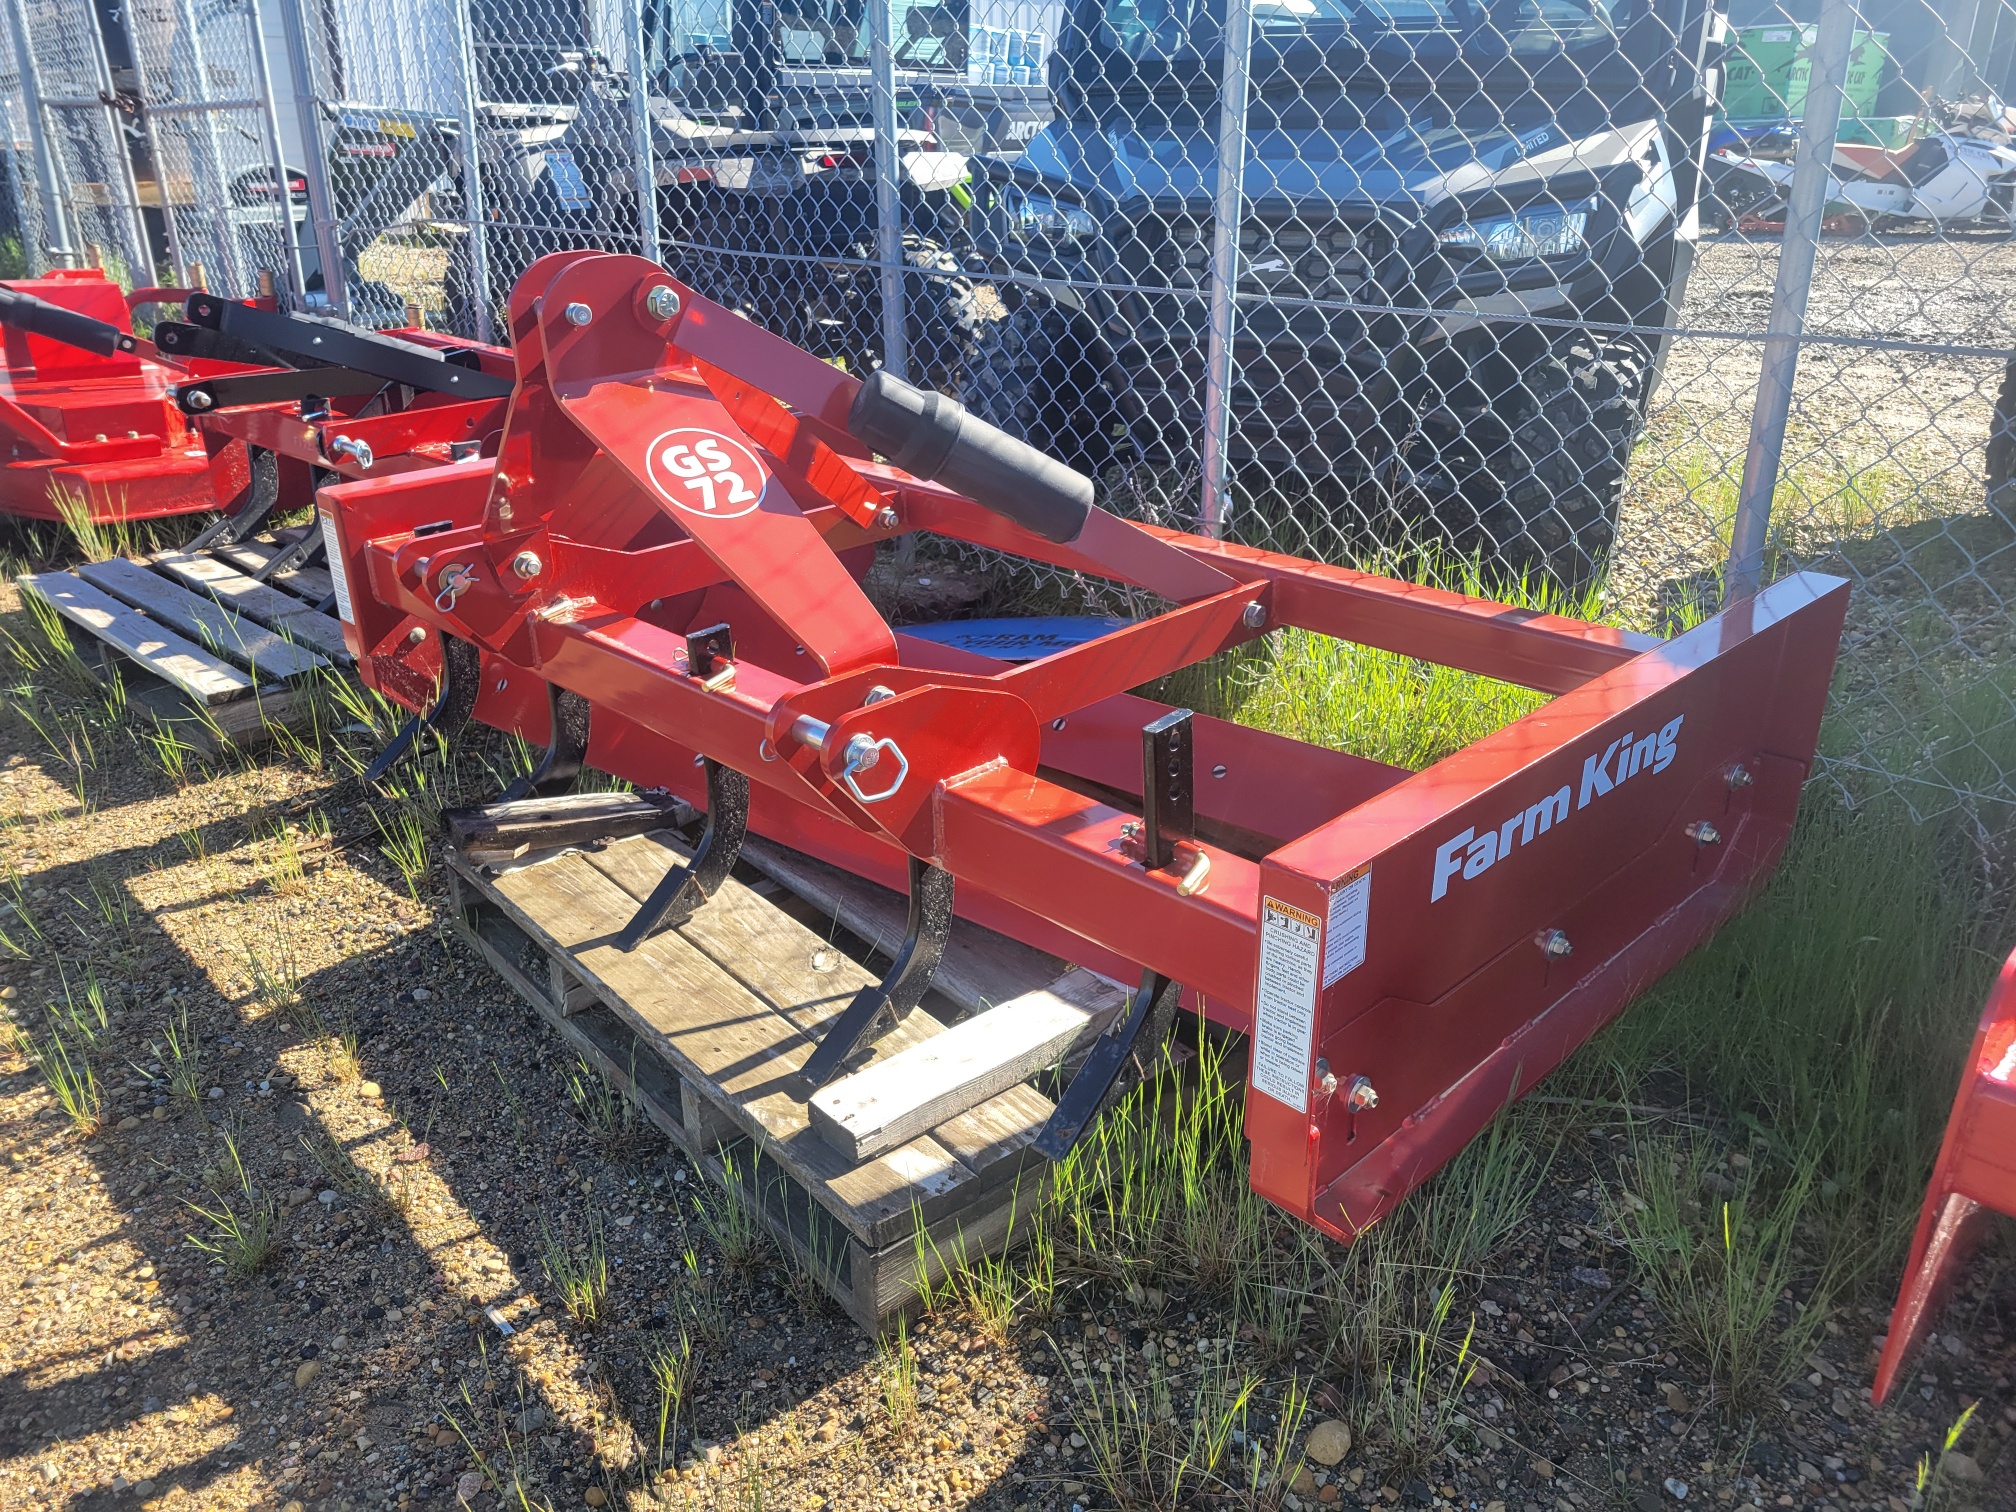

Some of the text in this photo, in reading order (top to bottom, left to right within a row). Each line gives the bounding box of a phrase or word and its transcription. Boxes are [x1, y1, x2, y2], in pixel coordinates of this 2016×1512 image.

[1005, 121, 1050, 140] ARCT
[1513, 131, 1550, 157] LMITED
[661, 439, 732, 477] GS
[683, 471, 757, 510] 72
[1431, 713, 1684, 903] Farm King
[1275, 902, 1317, 926] WARNING
